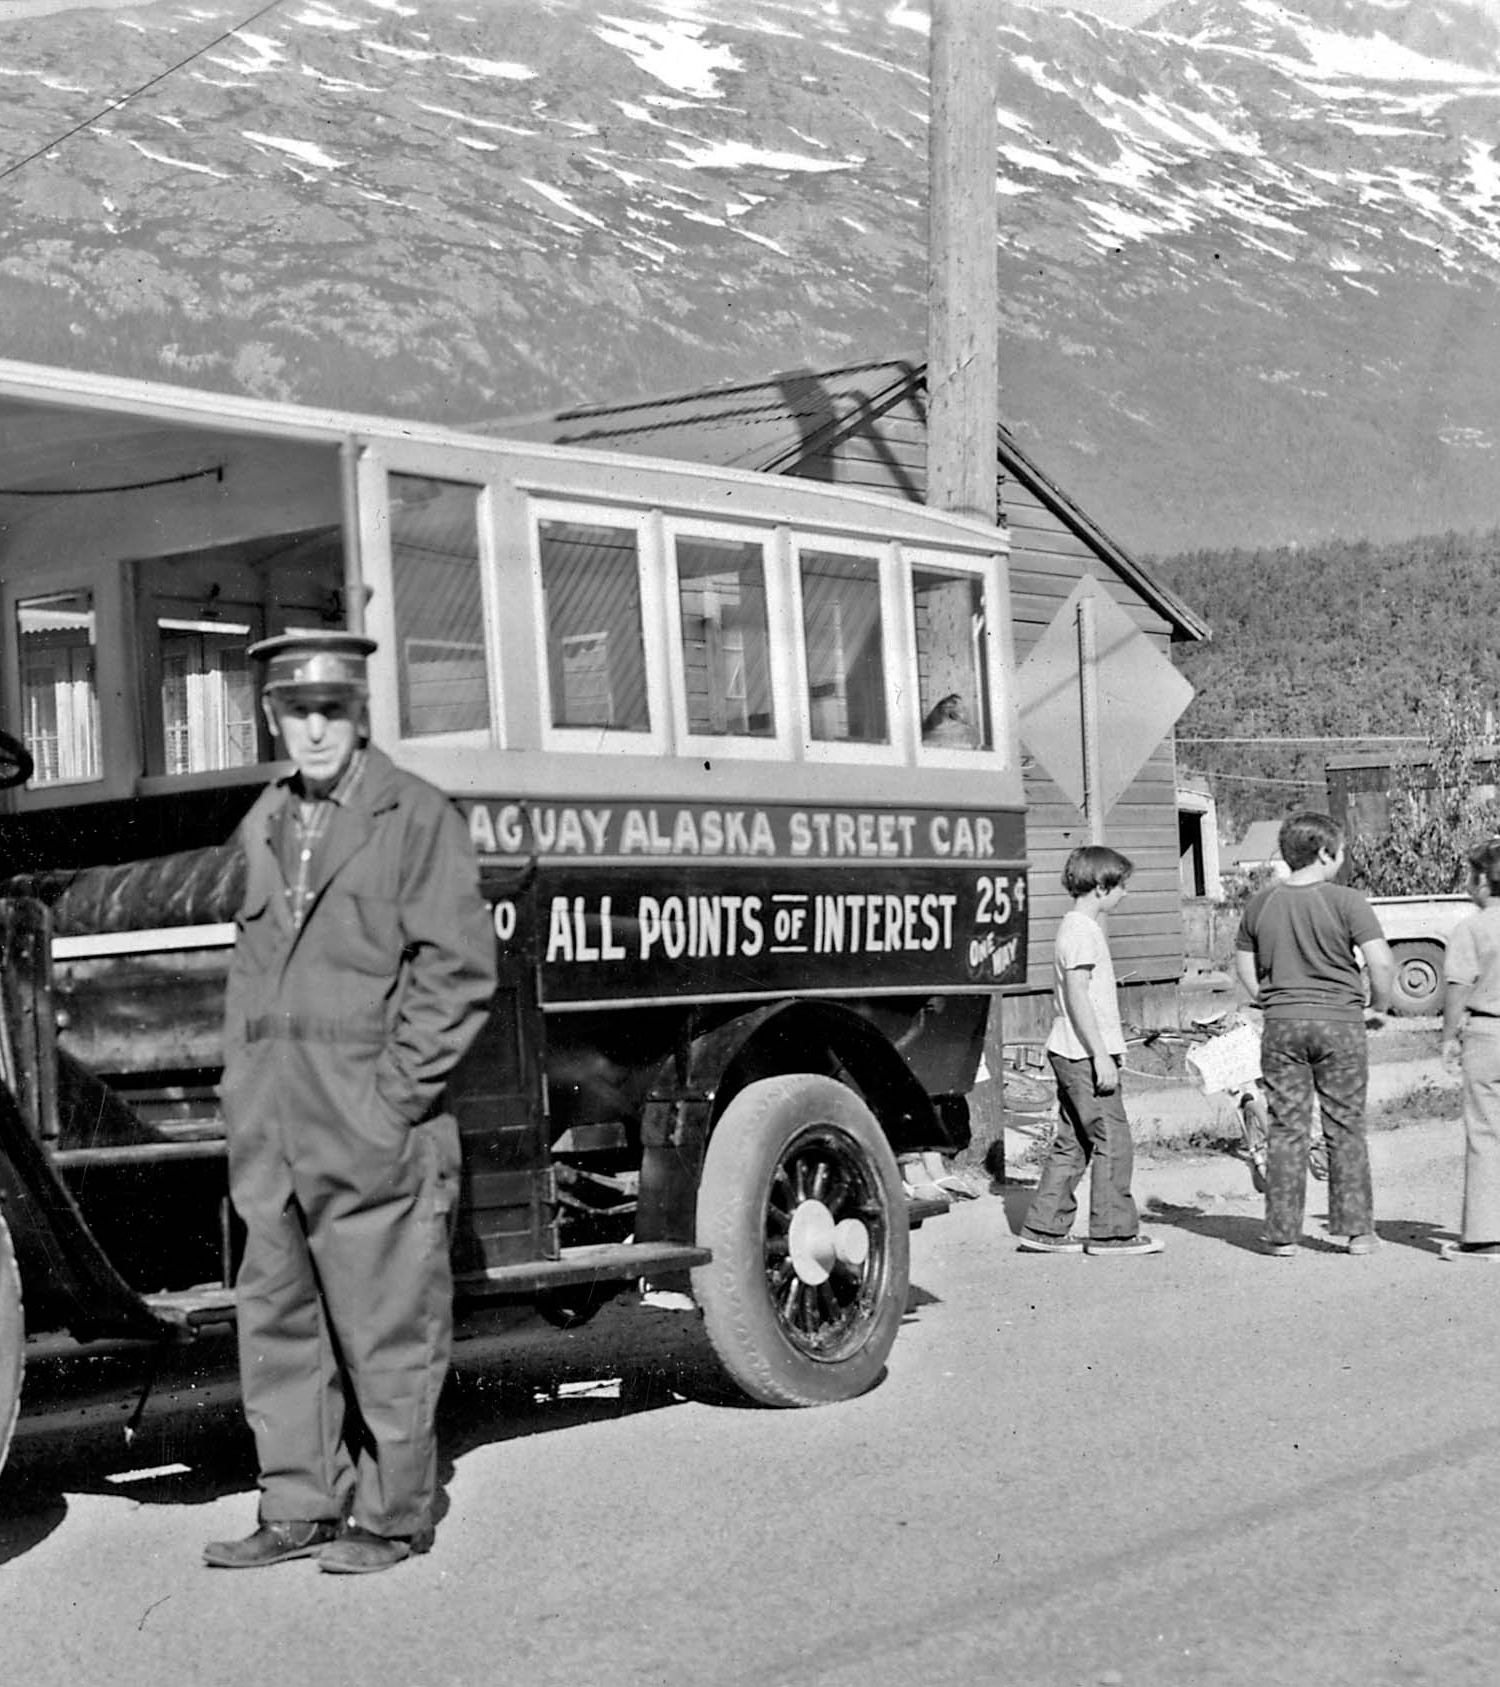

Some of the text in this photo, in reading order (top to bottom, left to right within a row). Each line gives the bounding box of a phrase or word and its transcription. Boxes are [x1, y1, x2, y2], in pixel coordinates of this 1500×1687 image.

[469, 804, 995, 858] AGUAY ALASKA STREET CAR
[975, 875, 1026, 924] 25¢
[485, 893, 957, 962] O ALL POINTS OF INTEREST
[969, 931, 996, 968] ONE
